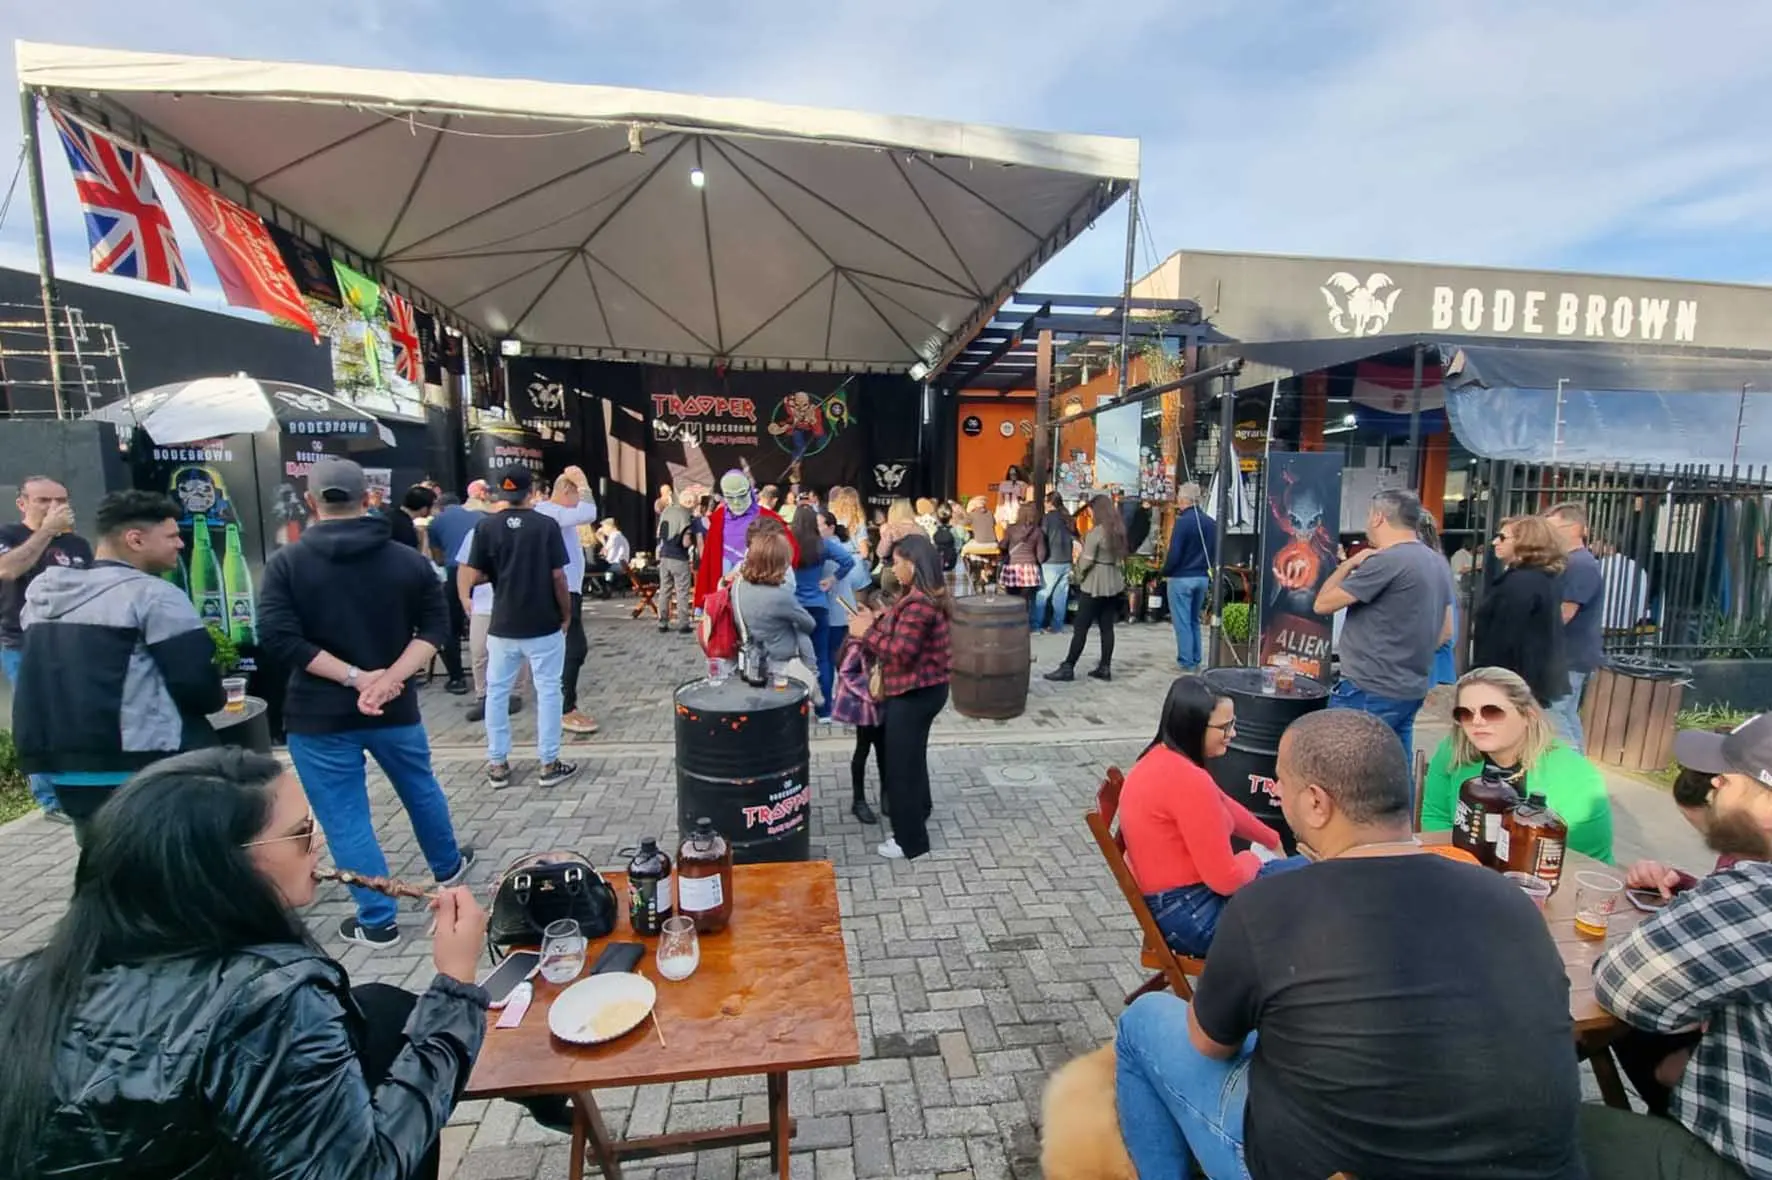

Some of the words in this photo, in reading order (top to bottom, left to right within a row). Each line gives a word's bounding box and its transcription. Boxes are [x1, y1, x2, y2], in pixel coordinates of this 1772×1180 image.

[1432, 286, 1698, 342] BODEBROWN
[651, 393, 757, 422] TROOPER
[288, 421, 367, 434] BODEBROWN
[153, 449, 232, 462] BODEBROWN
[1275, 628, 1330, 660] ALIEN
